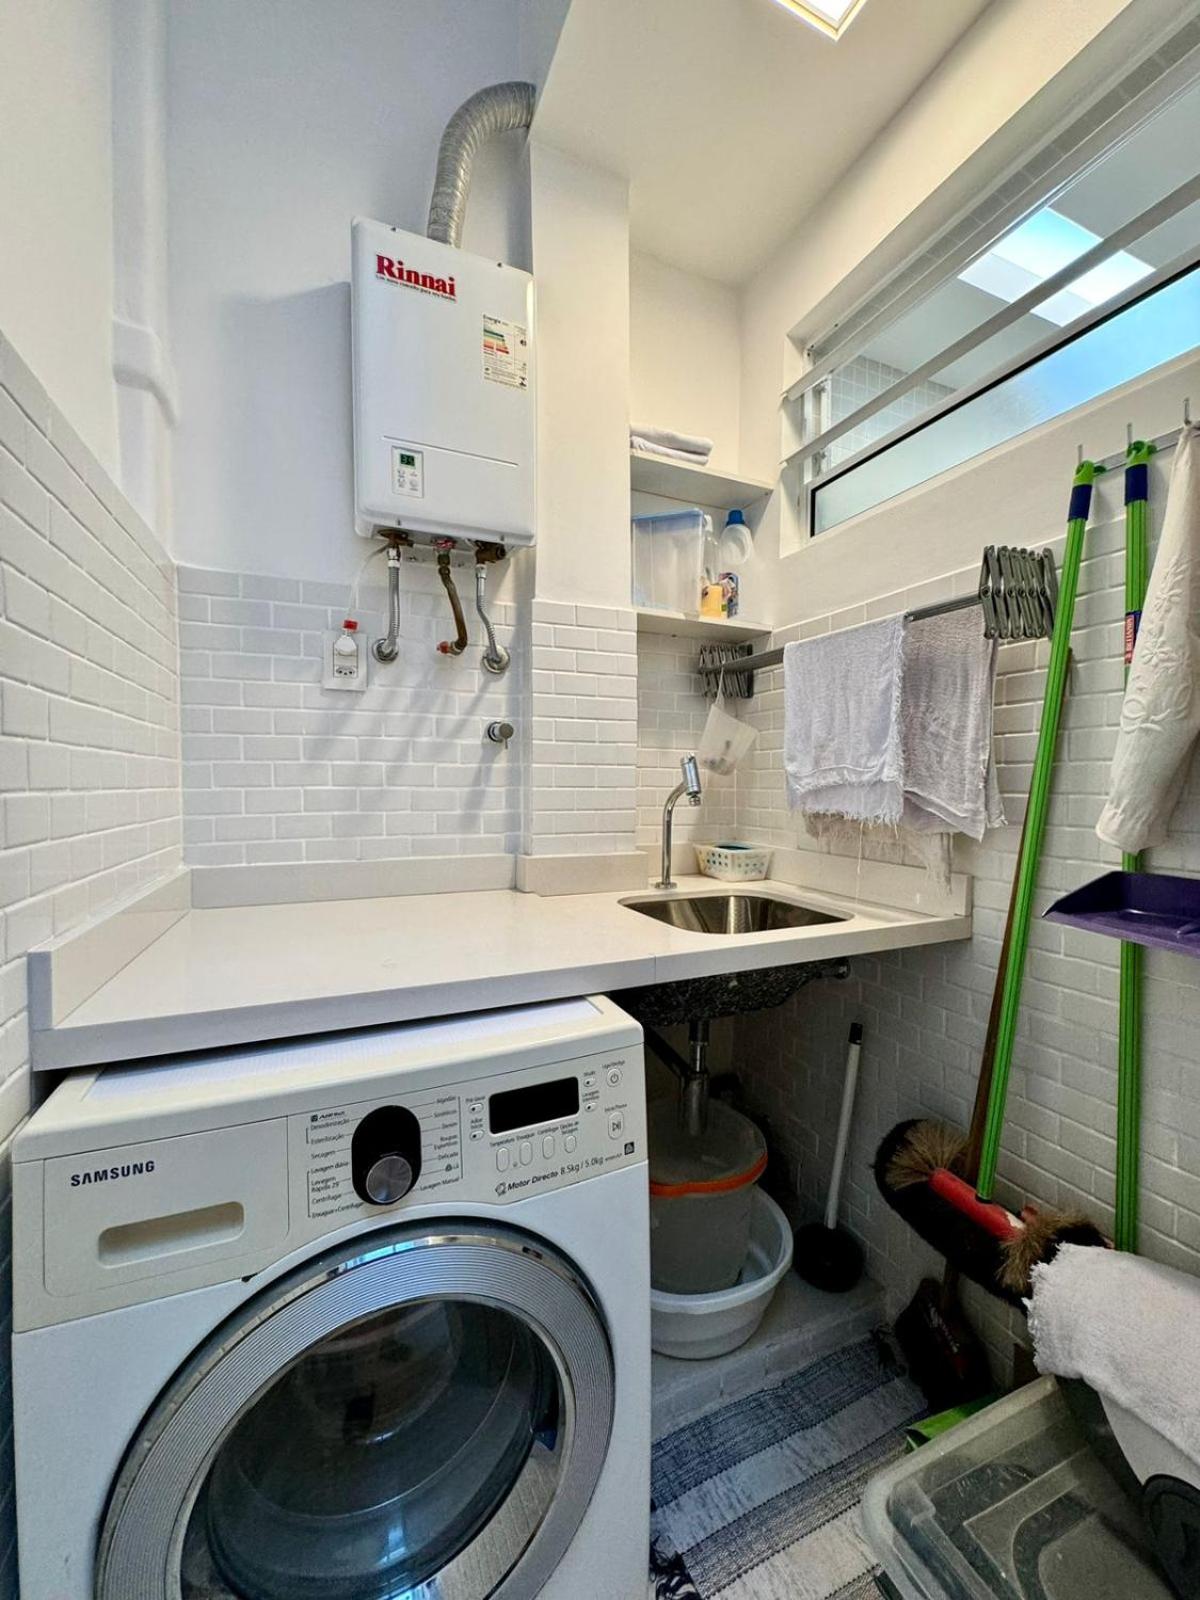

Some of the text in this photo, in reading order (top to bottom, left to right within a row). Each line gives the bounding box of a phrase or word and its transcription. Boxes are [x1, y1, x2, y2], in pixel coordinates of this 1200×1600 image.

[376, 254, 456, 296] Rinnai
[70, 1160, 155, 1187] SAMSUNG
[507, 1178, 530, 1191] Motor
[560, 1163, 580, 1176] 8.5kg
[585, 1156, 604, 1168] 5.0kg
